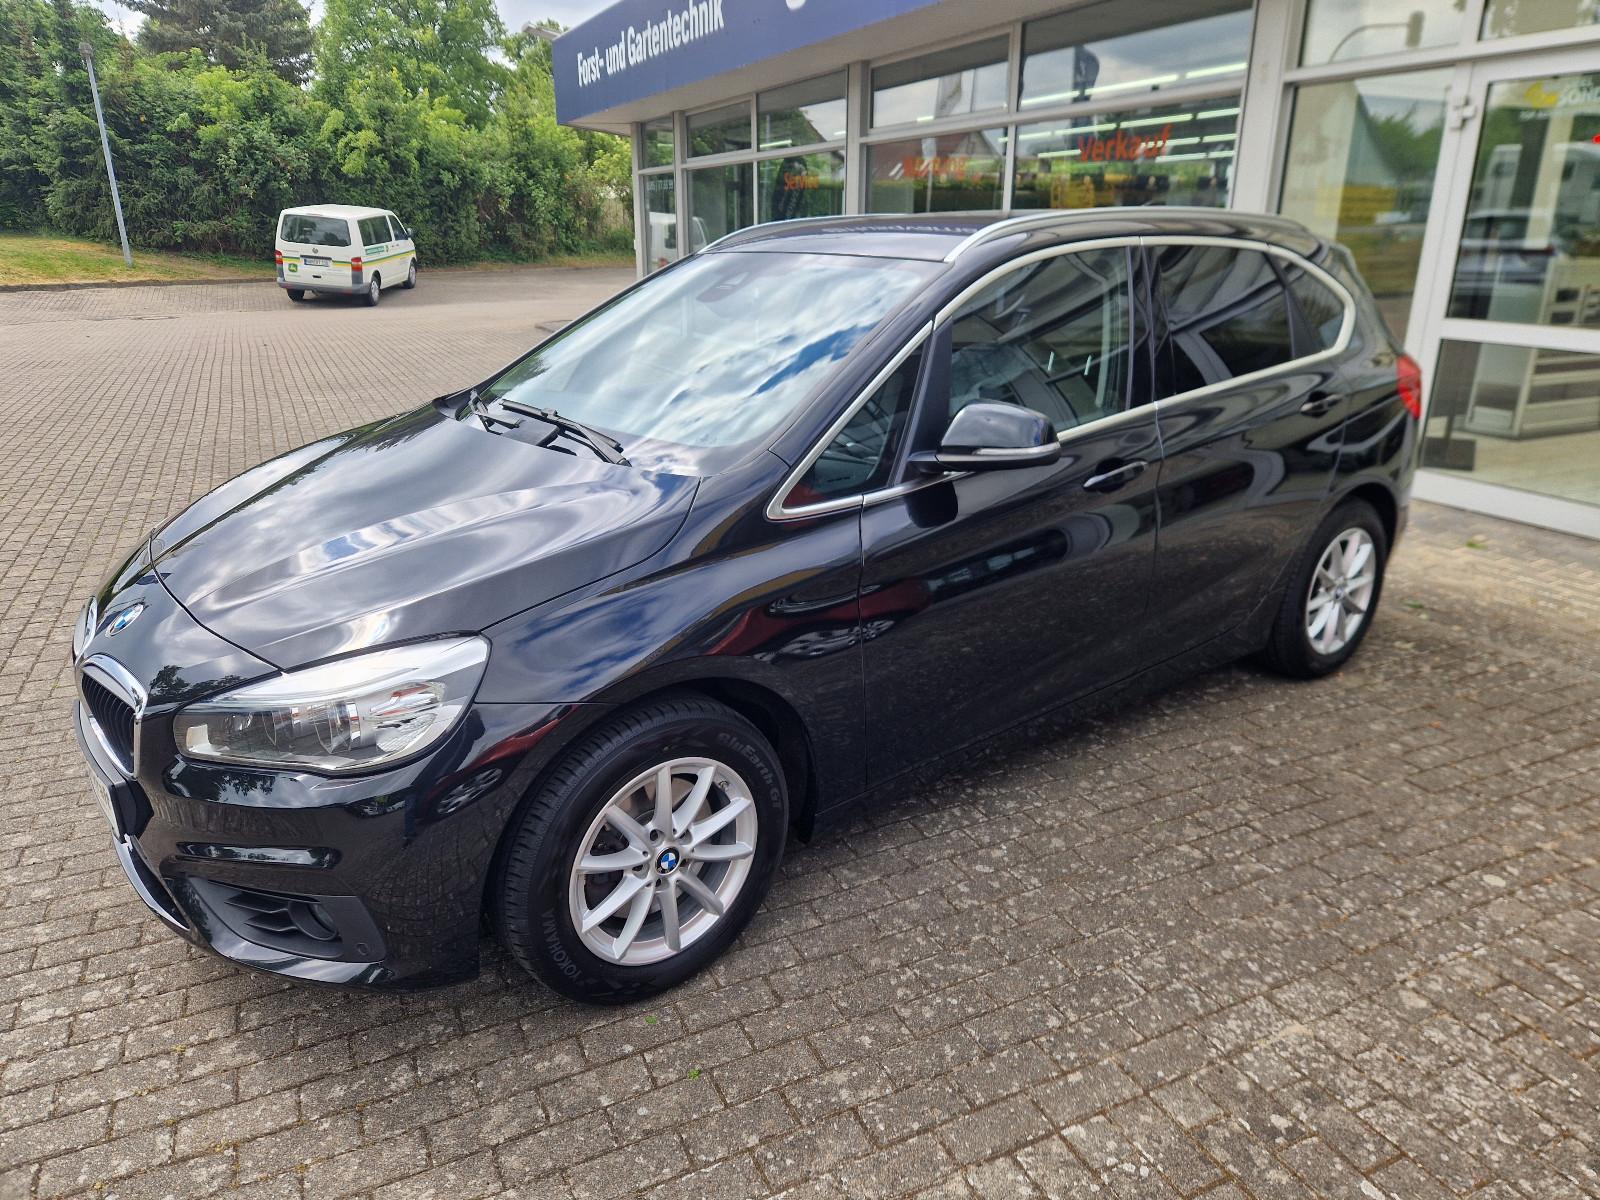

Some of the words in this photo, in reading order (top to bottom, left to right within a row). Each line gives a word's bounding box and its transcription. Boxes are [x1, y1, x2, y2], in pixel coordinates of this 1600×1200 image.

[577, 46, 604, 88] Forst-
[605, 31, 626, 76] und
[627, 0, 725, 67] Gartentechnik
[1077, 122, 1174, 163] Verkauf
[541, 907, 583, 982] YOKOHAMA
